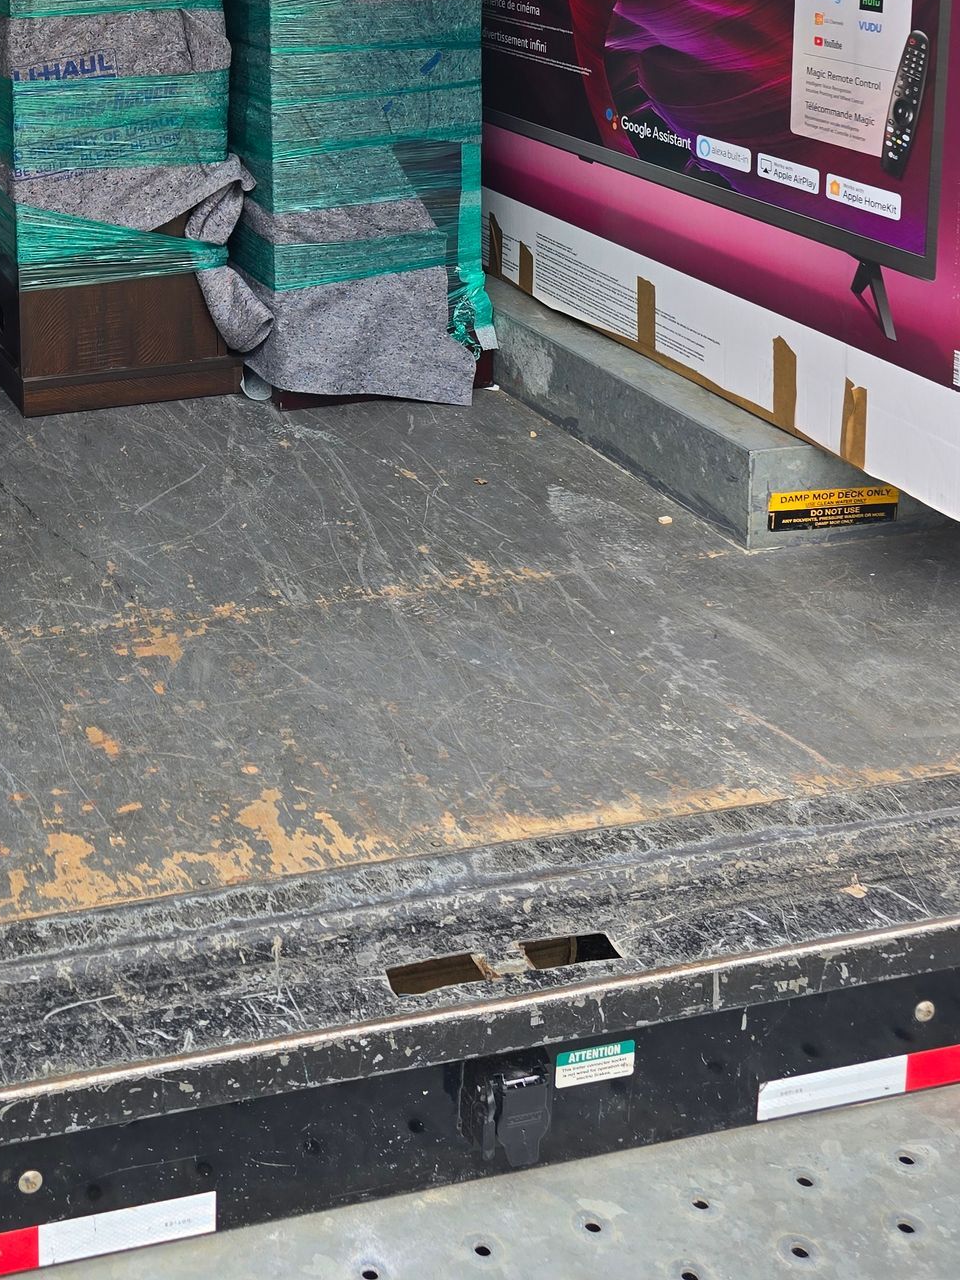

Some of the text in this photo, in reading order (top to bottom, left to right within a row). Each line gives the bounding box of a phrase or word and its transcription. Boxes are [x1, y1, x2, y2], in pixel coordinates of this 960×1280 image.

[516, 1, 540, 16] cinéma
[858, 21, 883, 33] VUDU
[529, 38, 547, 53] infini
[823, 38, 842, 50] YouTube
[806, 66, 881, 91] Magic Remote Control
[804, 100, 853, 121] Télécommande
[854, 113, 875, 127] Magic
[620, 115, 691, 150] Google Assistant
[711, 145, 749, 164] alexa built-in
[773, 168, 817, 191] Apple AirPlay
[842, 190, 897, 215] Apple HomeKit
[780, 488, 892, 504] DAMP MOP DECK ONLY
[810, 509, 823, 517] DO
[824, 508, 842, 516] NOT
[568, 1043, 621, 1064] ATTENTION
